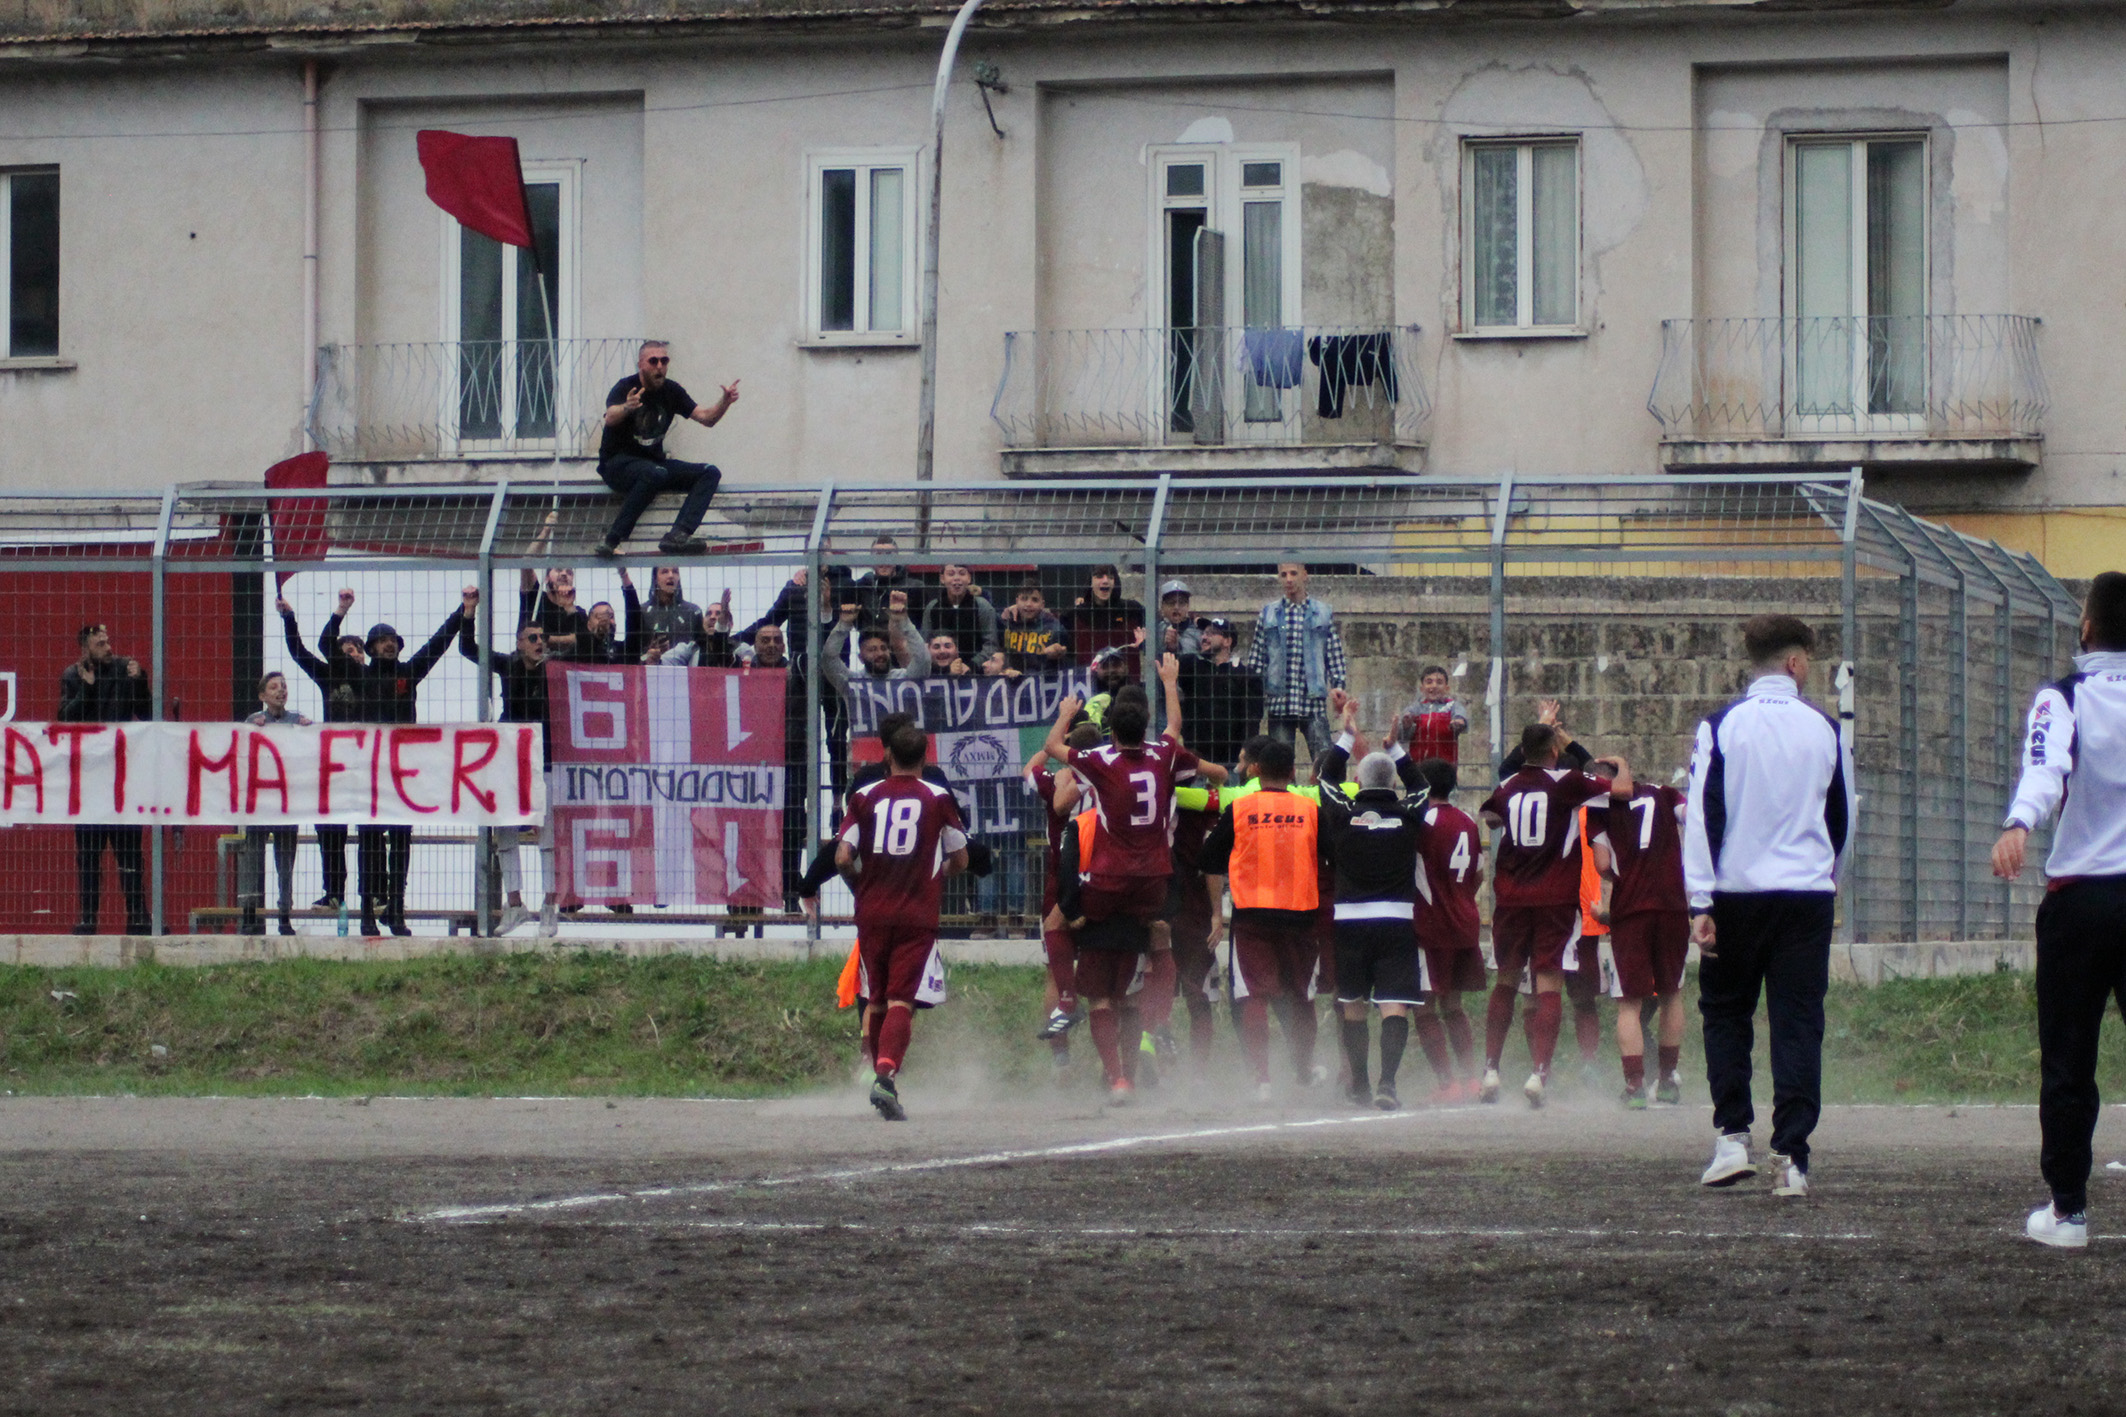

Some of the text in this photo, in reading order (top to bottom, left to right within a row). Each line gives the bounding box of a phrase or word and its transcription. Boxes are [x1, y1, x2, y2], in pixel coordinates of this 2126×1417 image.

[848, 667, 1092, 732] MADDALONI
[2030, 721, 2052, 766] Zeus
[186, 729, 288, 816] MA
[318, 728, 533, 817] FIERI
[566, 767, 773, 804] MADDALONI
[1129, 771, 1157, 826] 3
[873, 798, 922, 855] 18
[1261, 812, 1305, 824] Zeus
[1508, 791, 1548, 846] 10
[1629, 796, 1656, 849] 7
[1449, 831, 1471, 882] 4
